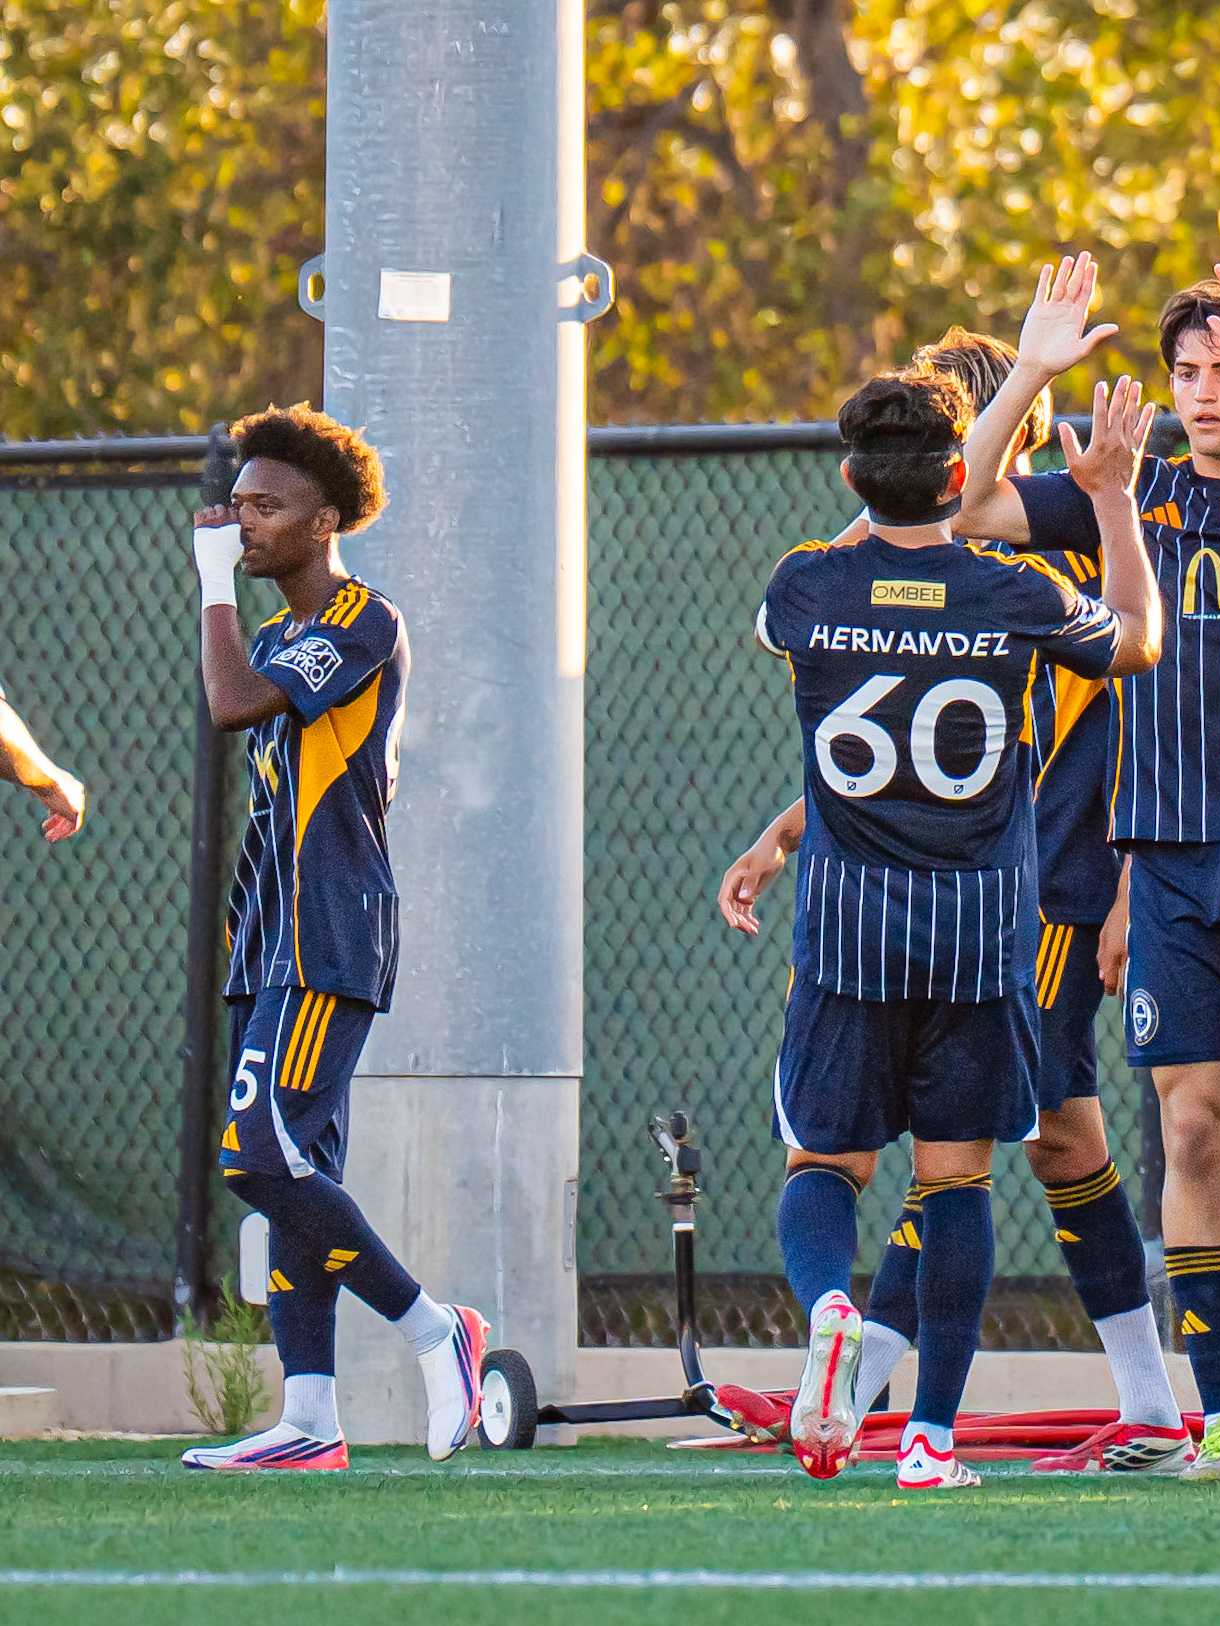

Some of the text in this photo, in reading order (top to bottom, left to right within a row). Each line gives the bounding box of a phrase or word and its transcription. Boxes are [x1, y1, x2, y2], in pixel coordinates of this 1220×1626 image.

[873, 585, 944, 602] OMBEE
[300, 640, 338, 669] NEXT
[808, 624, 1010, 657] HERNANDEZ
[294, 651, 325, 684] PRO
[814, 673, 1006, 800] 60
[230, 1047, 267, 1112] 5
